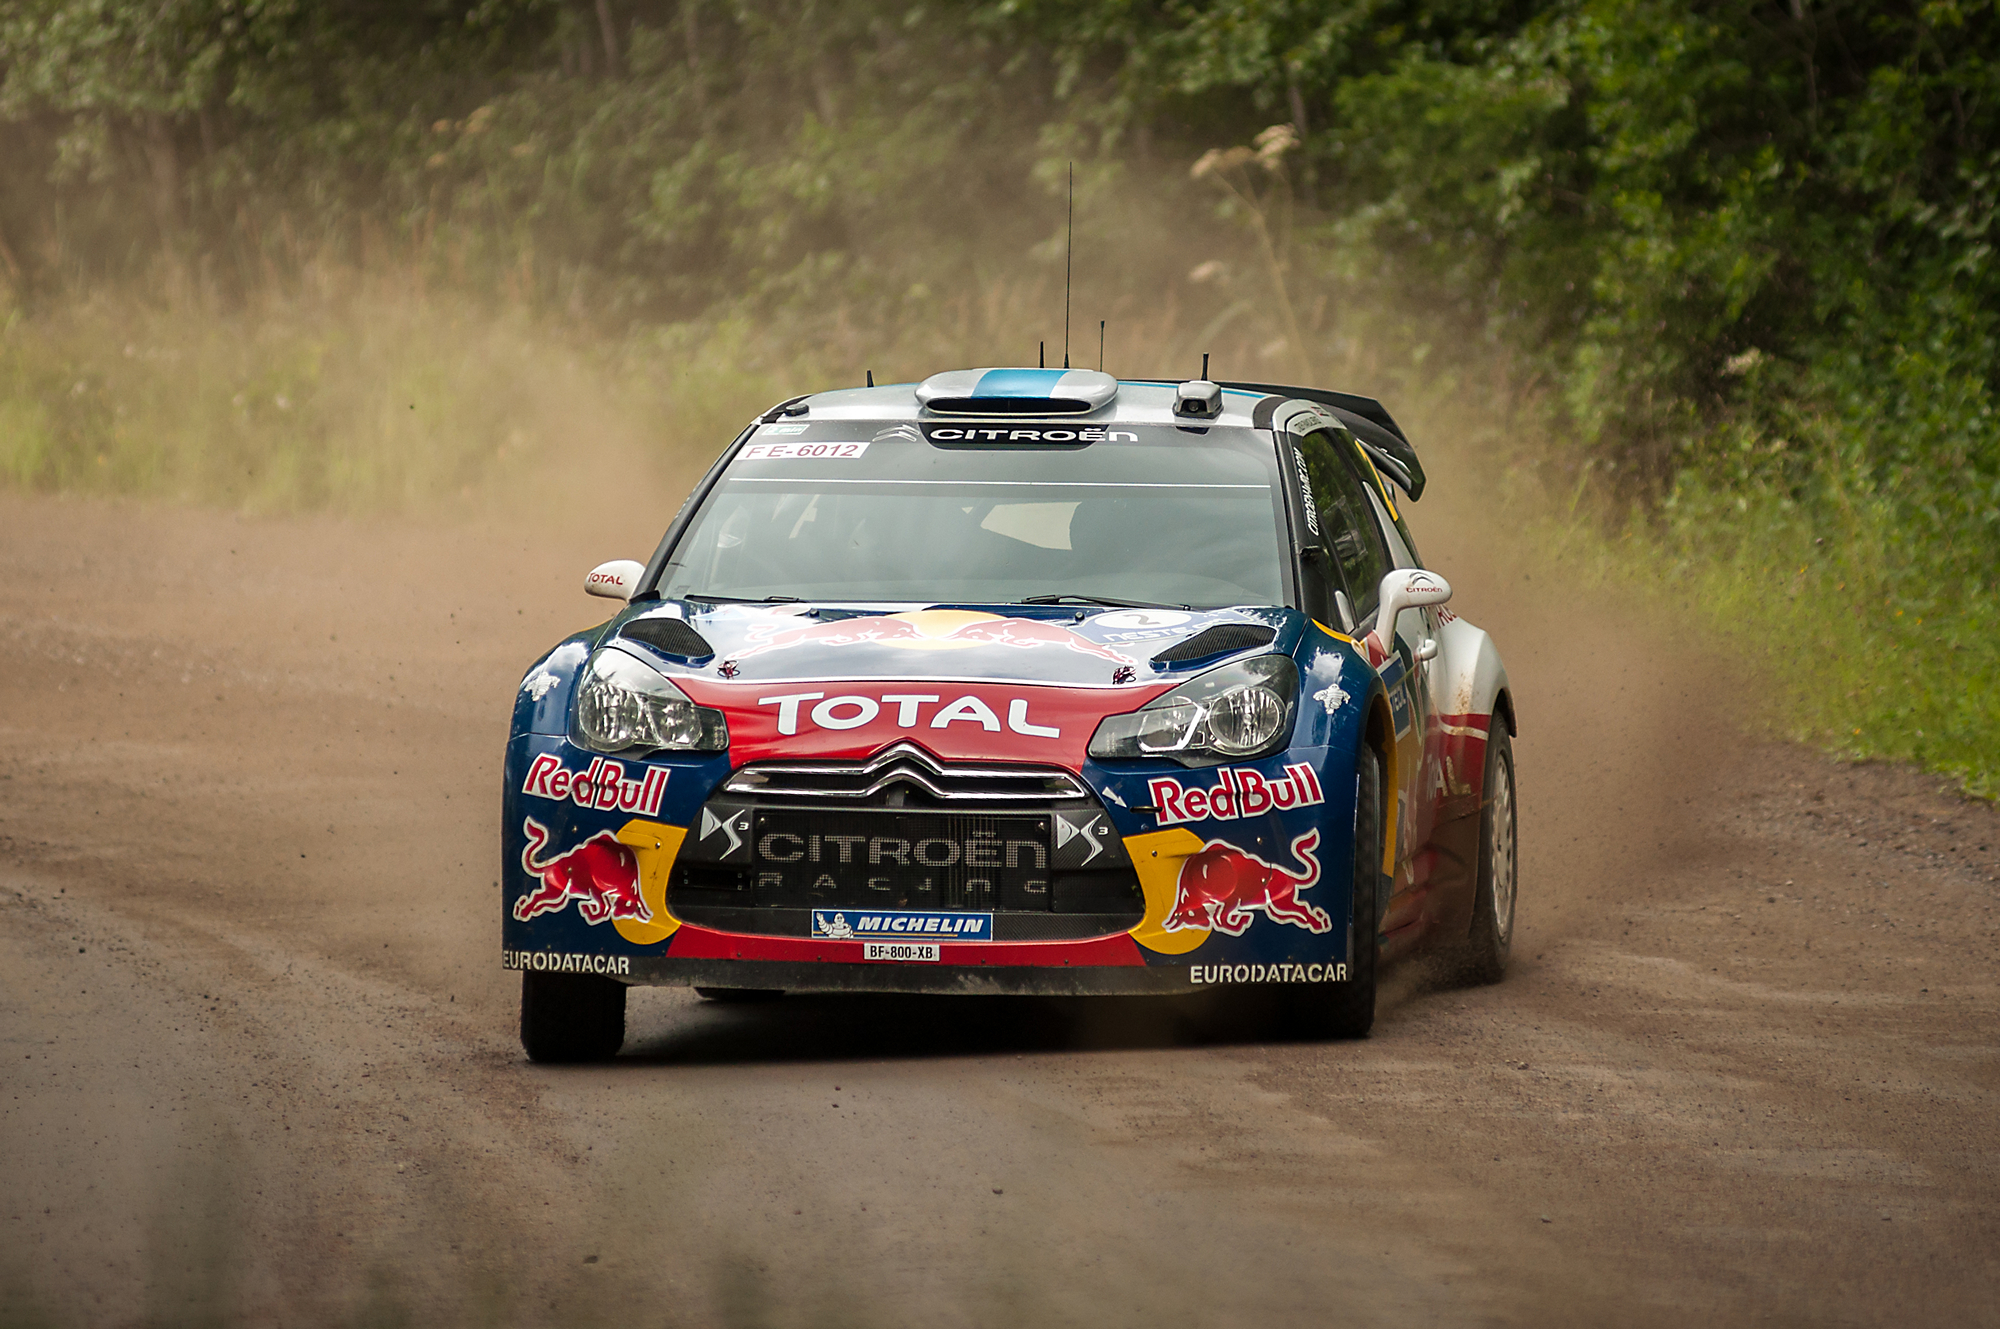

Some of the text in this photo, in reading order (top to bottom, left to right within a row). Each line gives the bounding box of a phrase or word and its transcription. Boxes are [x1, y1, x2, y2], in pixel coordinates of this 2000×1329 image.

[587, 572, 624, 586] TOTAL
[1123, 613, 1161, 626] 2
[757, 691, 1061, 739] TOTAL
[523, 754, 670, 815] Red Bull
[1149, 762, 1325, 825] Red Bull
[857, 916, 984, 933] MICHELIN
[503, 950, 630, 975] EURODATACAR
[870, 945, 933, 959] BF-800-XB
[1190, 963, 1347, 984] EURODATACAR
